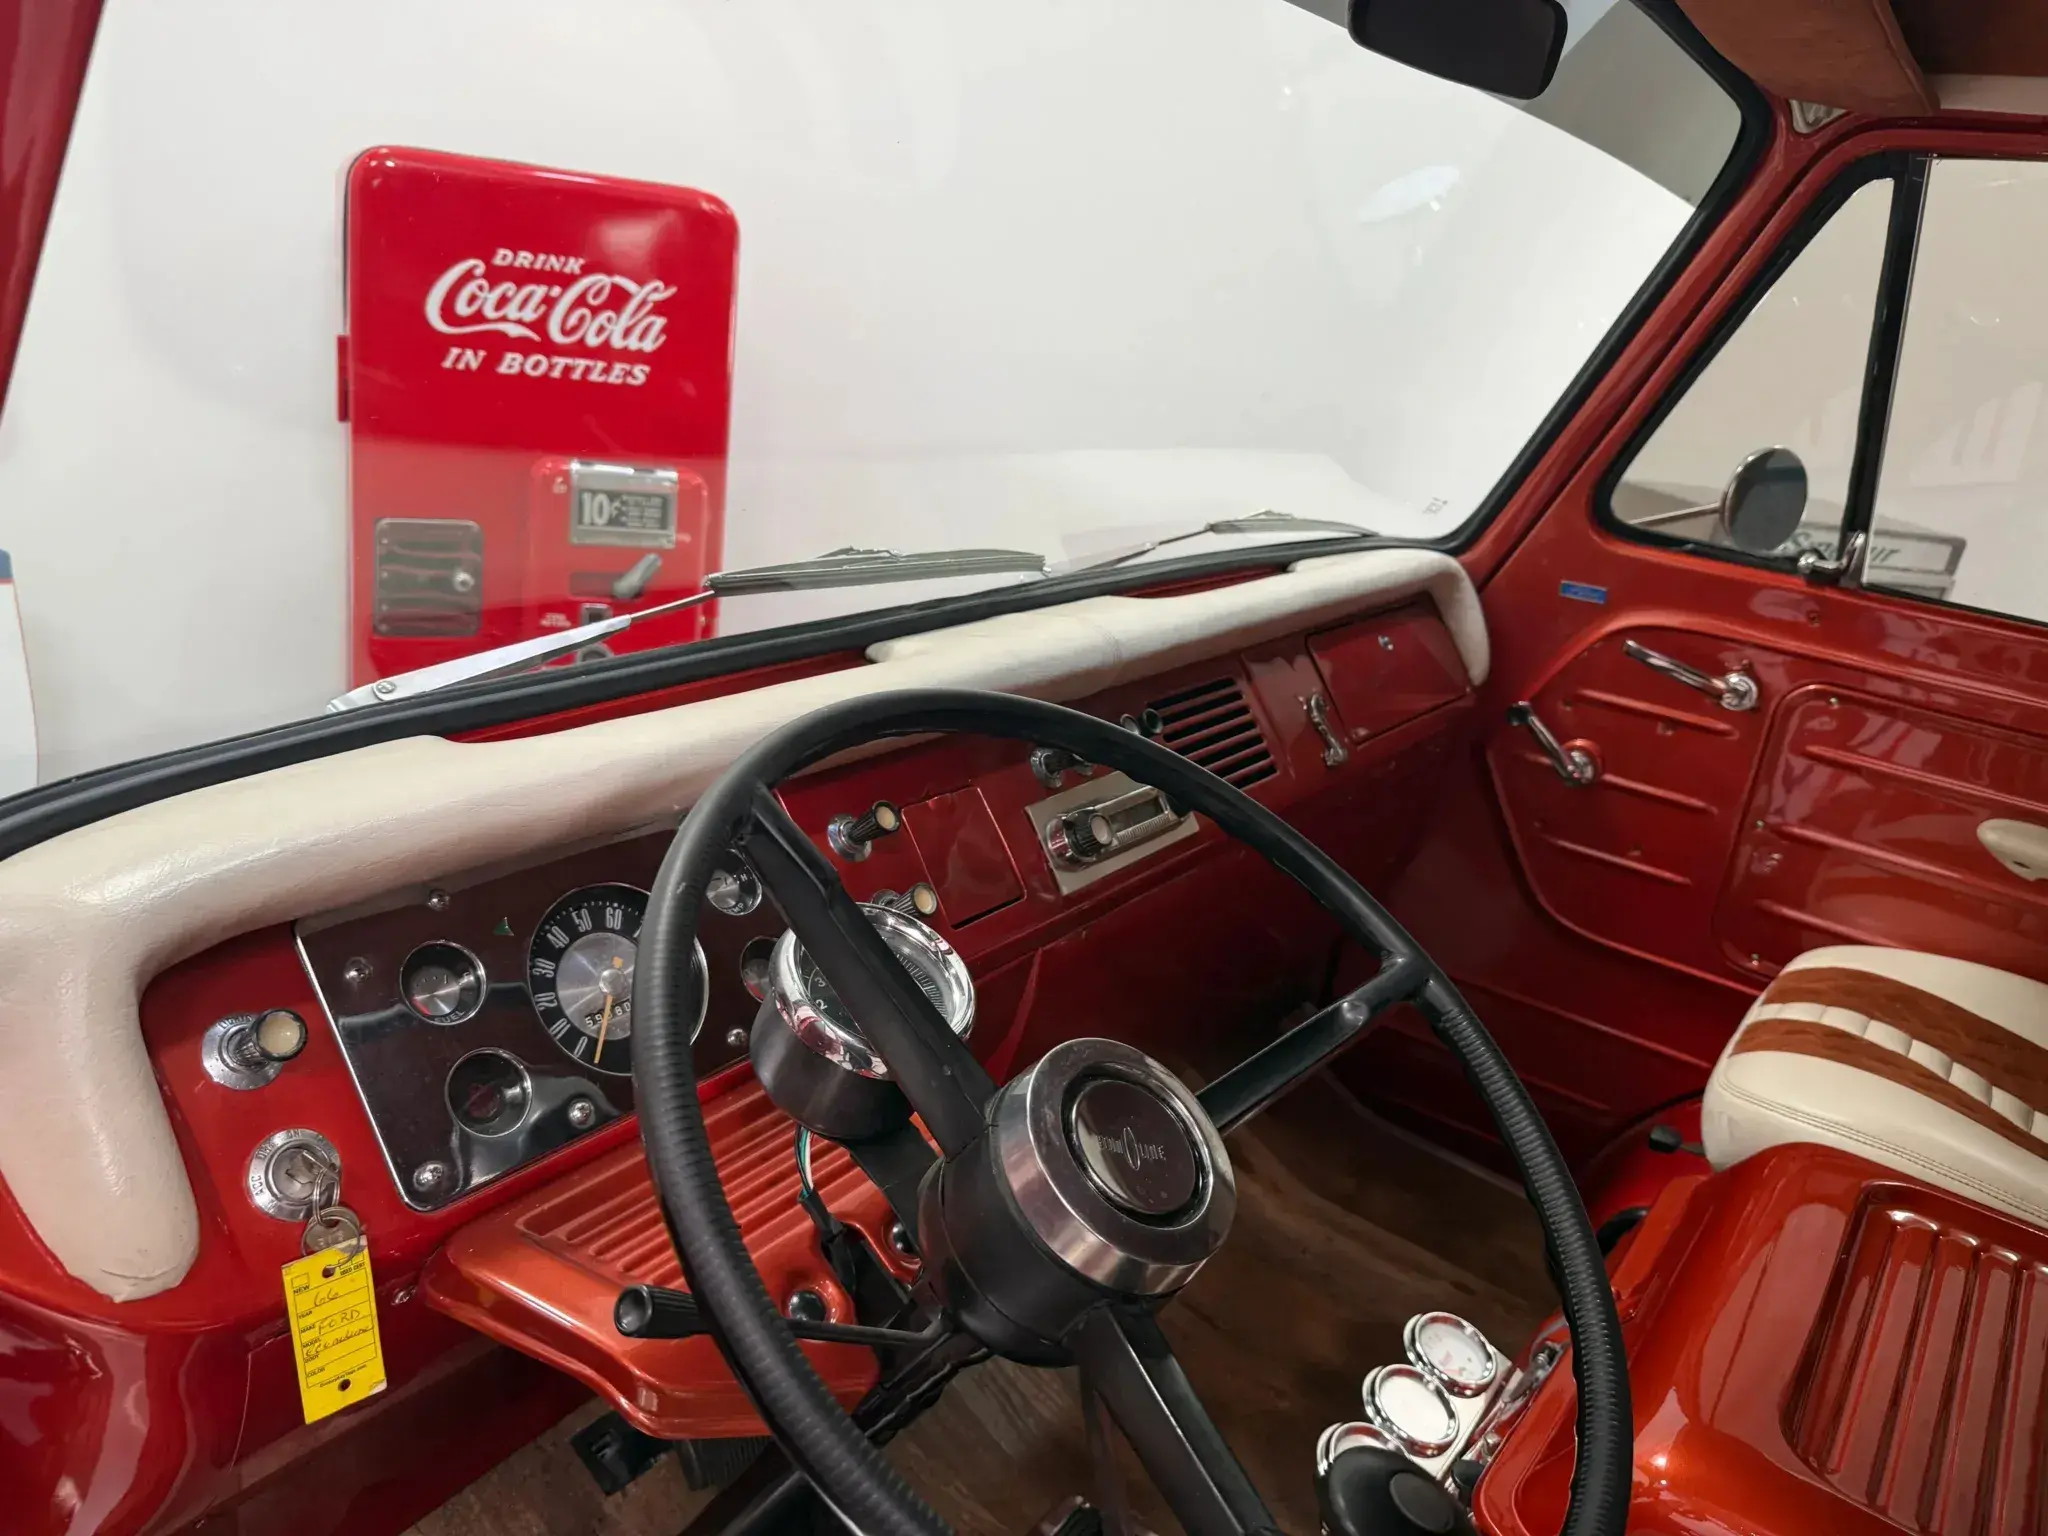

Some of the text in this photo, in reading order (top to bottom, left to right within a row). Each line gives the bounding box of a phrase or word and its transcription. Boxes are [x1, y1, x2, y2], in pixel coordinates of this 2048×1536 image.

[491, 248, 586, 275] DRINK
[424, 258, 678, 353] Coca-Cola
[441, 346, 651, 387] IN BOTTLES
[571, 907, 593, 933] 50
[605, 906, 623, 930] 60
[546, 925, 570, 949] 40
[532, 957, 556, 978] 30
[815, 976, 826, 988] 3
[534, 991, 557, 1011] 20
[816, 999, 828, 1010] 2
[434, 1010, 465, 1024] FUEL
[585, 1001, 631, 1028] 5980
[550, 1017, 571, 1040] 10
[573, 1035, 589, 1059] 0
[250, 1174, 263, 1197] ACC
[293, 1285, 310, 1295] NEW
[298, 1310, 313, 1320] YEAR
[318, 1309, 360, 1335] FORD
[300, 1323, 315, 1334] MAKE
[302, 1336, 321, 1348] MODEL
[307, 1366, 326, 1378] COLOR
